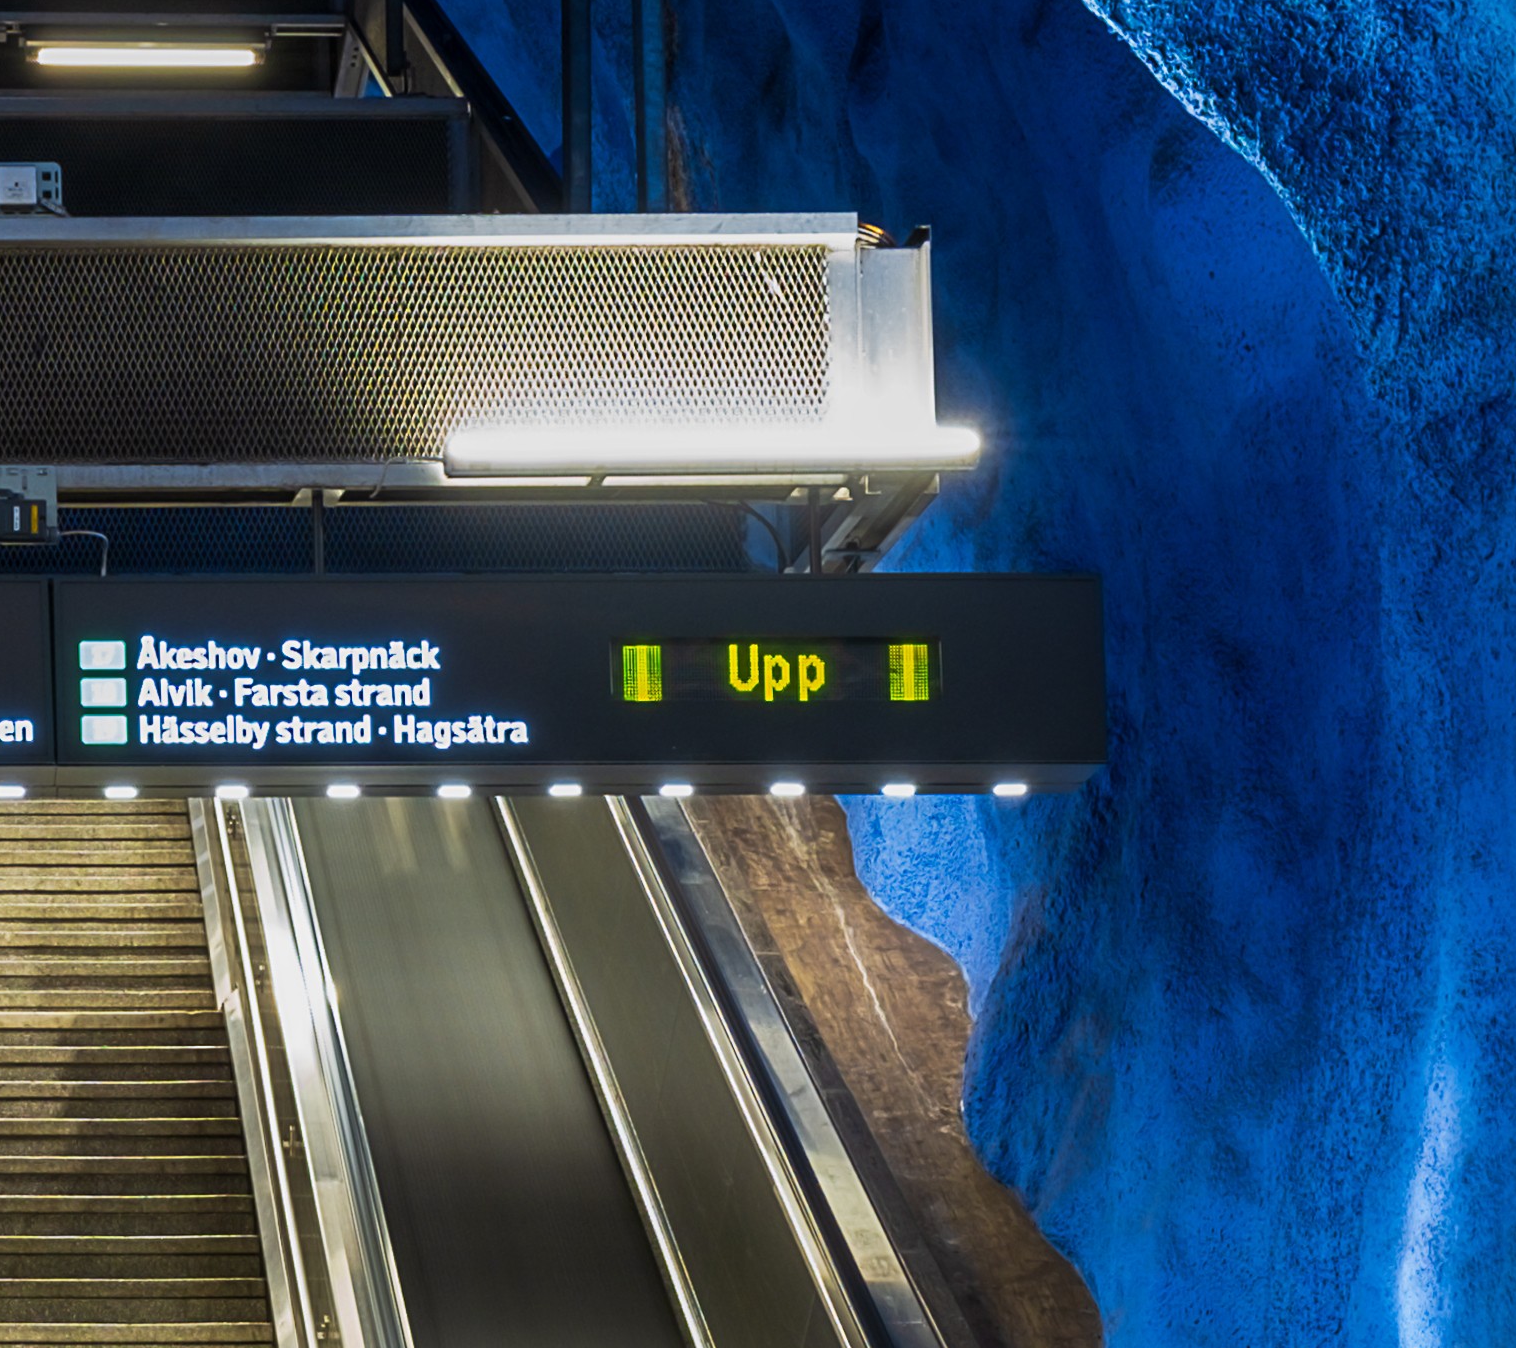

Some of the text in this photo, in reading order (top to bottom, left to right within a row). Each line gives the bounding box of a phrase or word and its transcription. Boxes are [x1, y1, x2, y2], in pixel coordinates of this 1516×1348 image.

[136, 635, 261, 670] Åkeshov
[281, 639, 441, 675] Skarpnäck
[727, 643, 827, 702] Upp
[137, 677, 214, 707] Alvik
[234, 677, 329, 707] Farsta
[334, 677, 431, 707] strand
[139, 714, 270, 750] Hässelby
[275, 714, 372, 744] strand
[393, 714, 529, 750] Hagsätra
